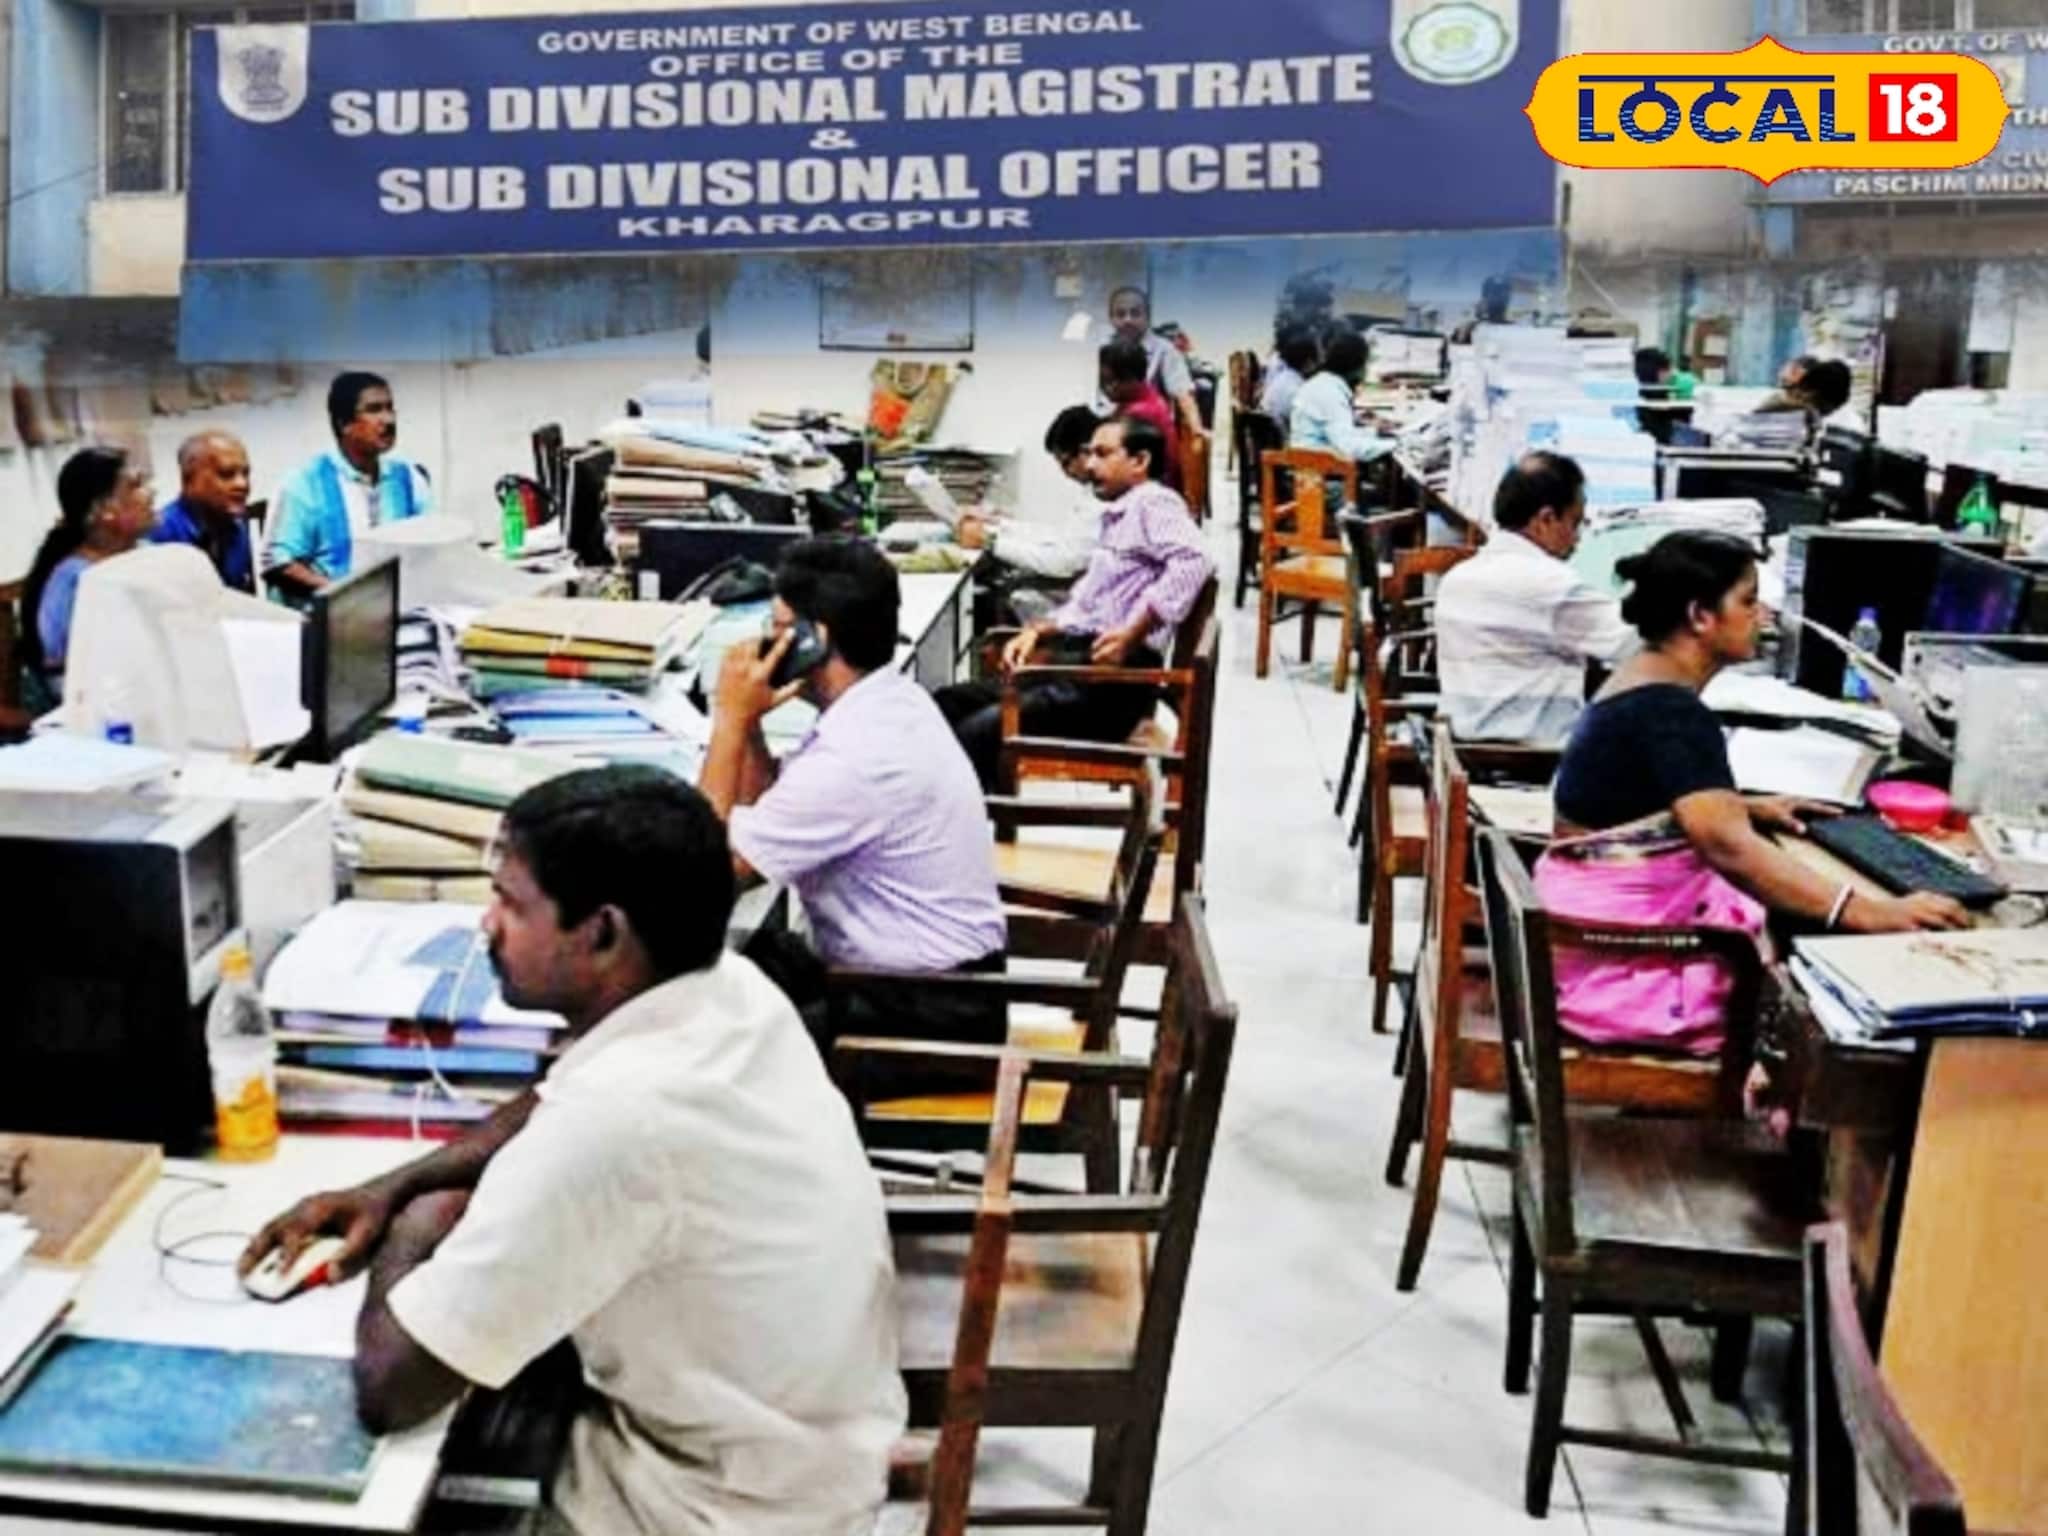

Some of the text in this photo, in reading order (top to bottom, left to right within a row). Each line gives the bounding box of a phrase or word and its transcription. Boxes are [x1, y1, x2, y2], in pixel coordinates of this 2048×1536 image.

[538, 10, 1142, 53] GOVERNMENT OF WEST BENGAL
[1977, 33, 2018, 50] OF
[650, 42, 1023, 77] OFFICE OF THE
[330, 53, 1373, 136] SUB DIVISIONAL MAGISTRATE
[809, 128, 857, 150] &
[379, 142, 1321, 213] SUB DIVISIONAL OFFICER
[1833, 174, 1967, 195] PASCHIM
[618, 207, 1030, 238] KHARAGPUR
